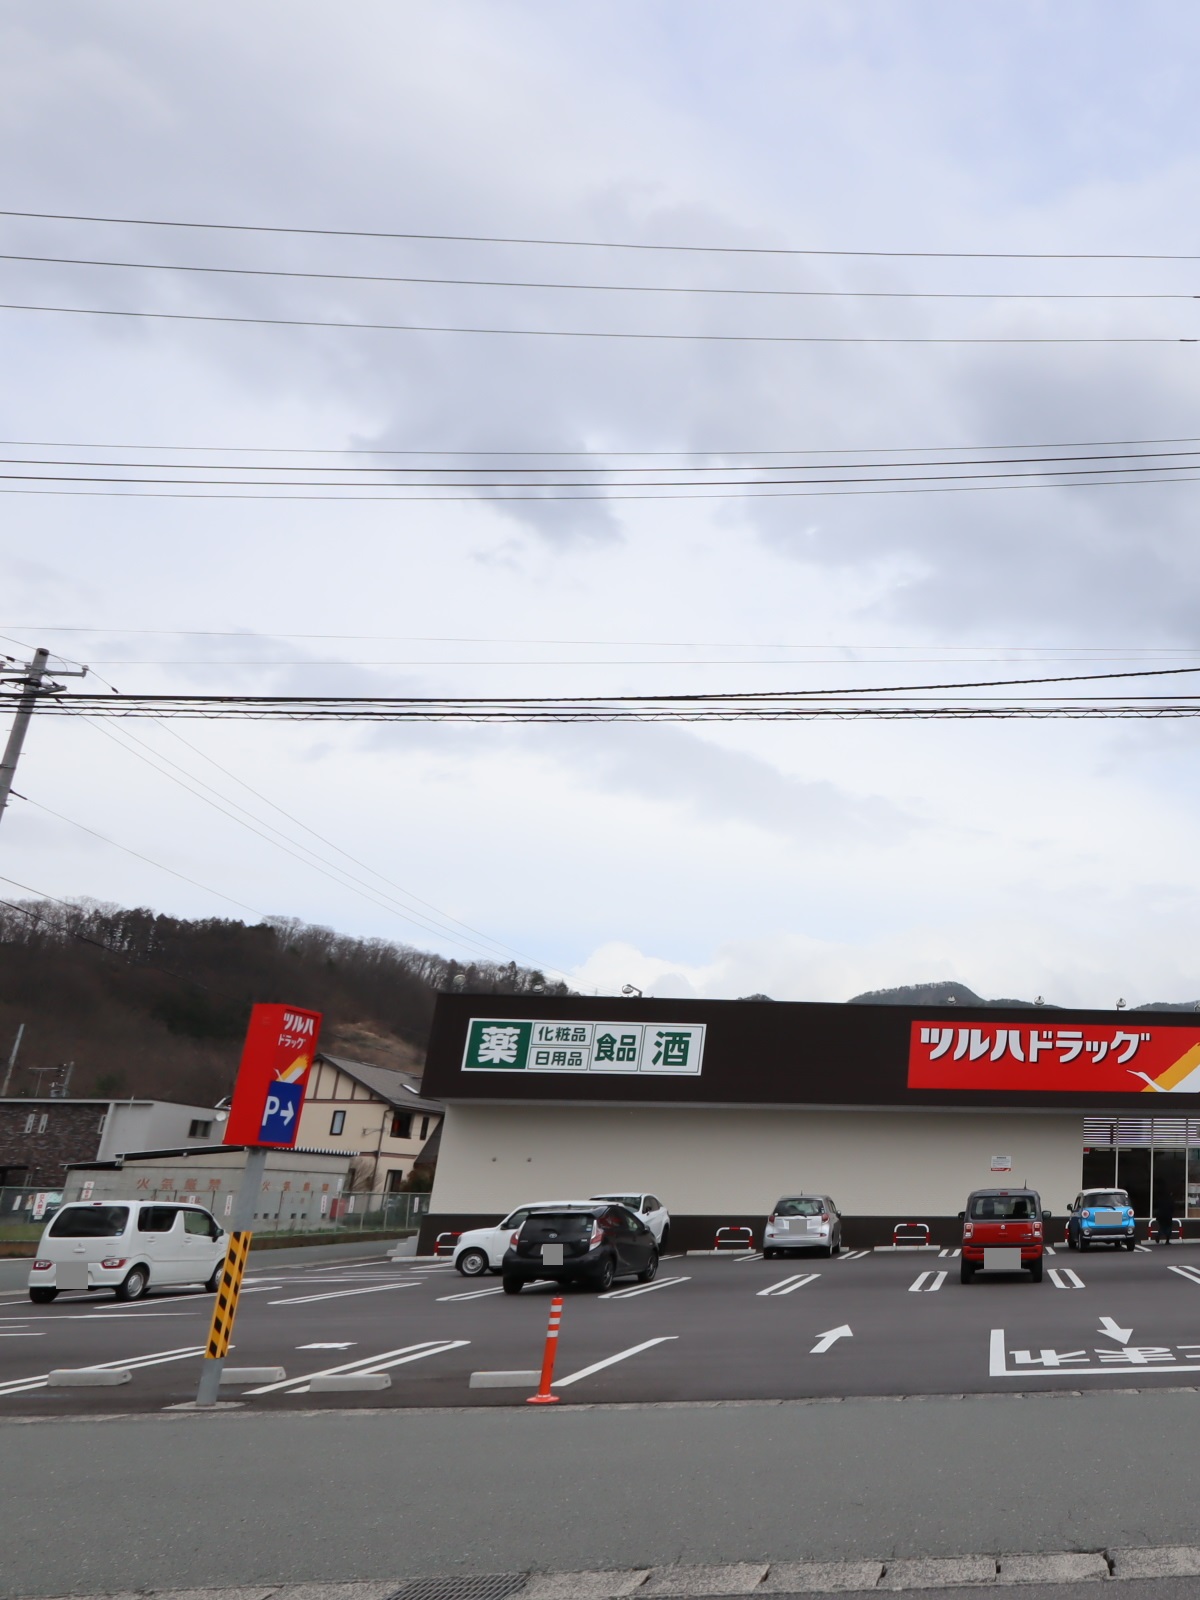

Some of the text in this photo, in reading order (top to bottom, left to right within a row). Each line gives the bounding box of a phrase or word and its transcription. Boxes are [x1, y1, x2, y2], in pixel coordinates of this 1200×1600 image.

[284, 1012, 314, 1036] ツルハ
[538, 1026, 586, 1042] 化粧品
[278, 1034, 307, 1049] ドラッグ
[477, 1026, 521, 1064] 薬
[594, 1033, 637, 1062] 食品
[652, 1031, 692, 1067] 酒
[920, 1027, 1151, 1064] ツルハドラッグ
[535, 1051, 583, 1067] 日用品
[262, 1096, 280, 1127] P
